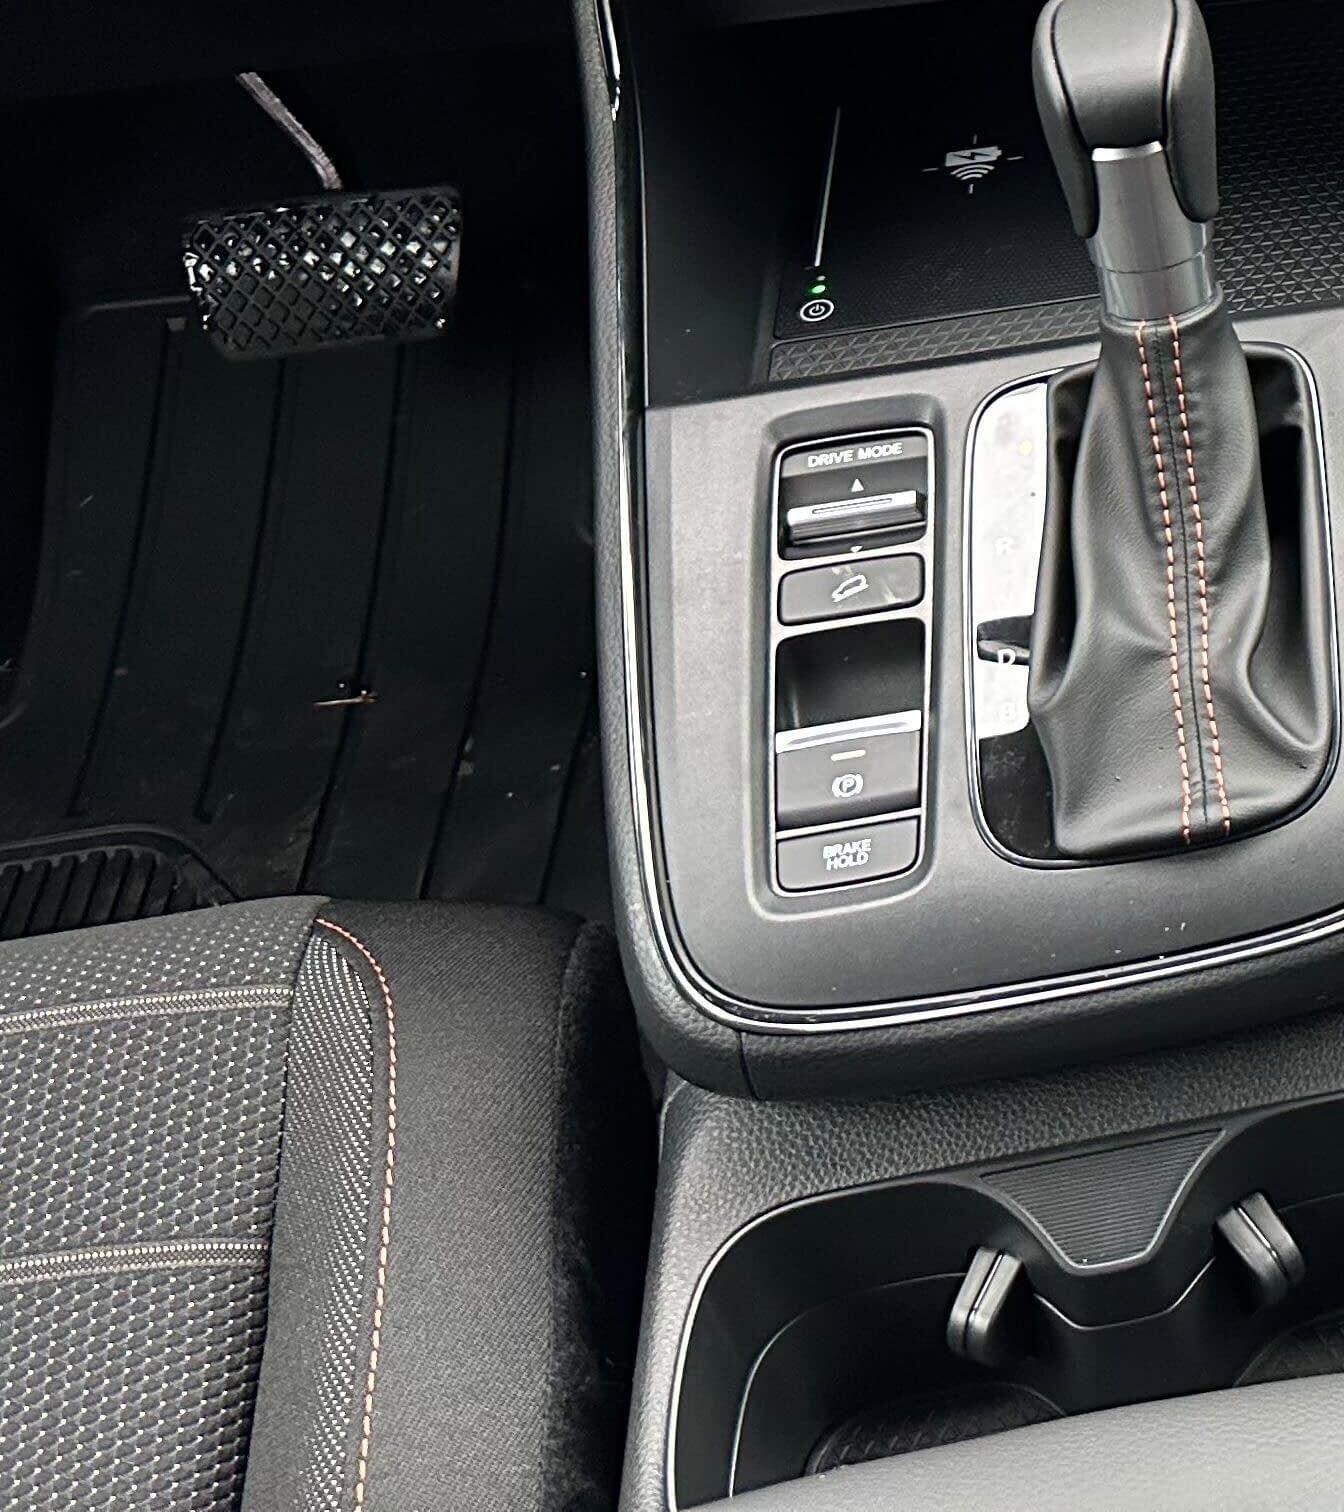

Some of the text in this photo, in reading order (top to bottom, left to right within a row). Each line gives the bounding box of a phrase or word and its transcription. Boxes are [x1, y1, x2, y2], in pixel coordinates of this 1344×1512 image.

[807, 441, 903, 468] DRIVE MODE
[822, 838, 872, 860] BRAKE
[825, 850, 869, 872] HOLD
